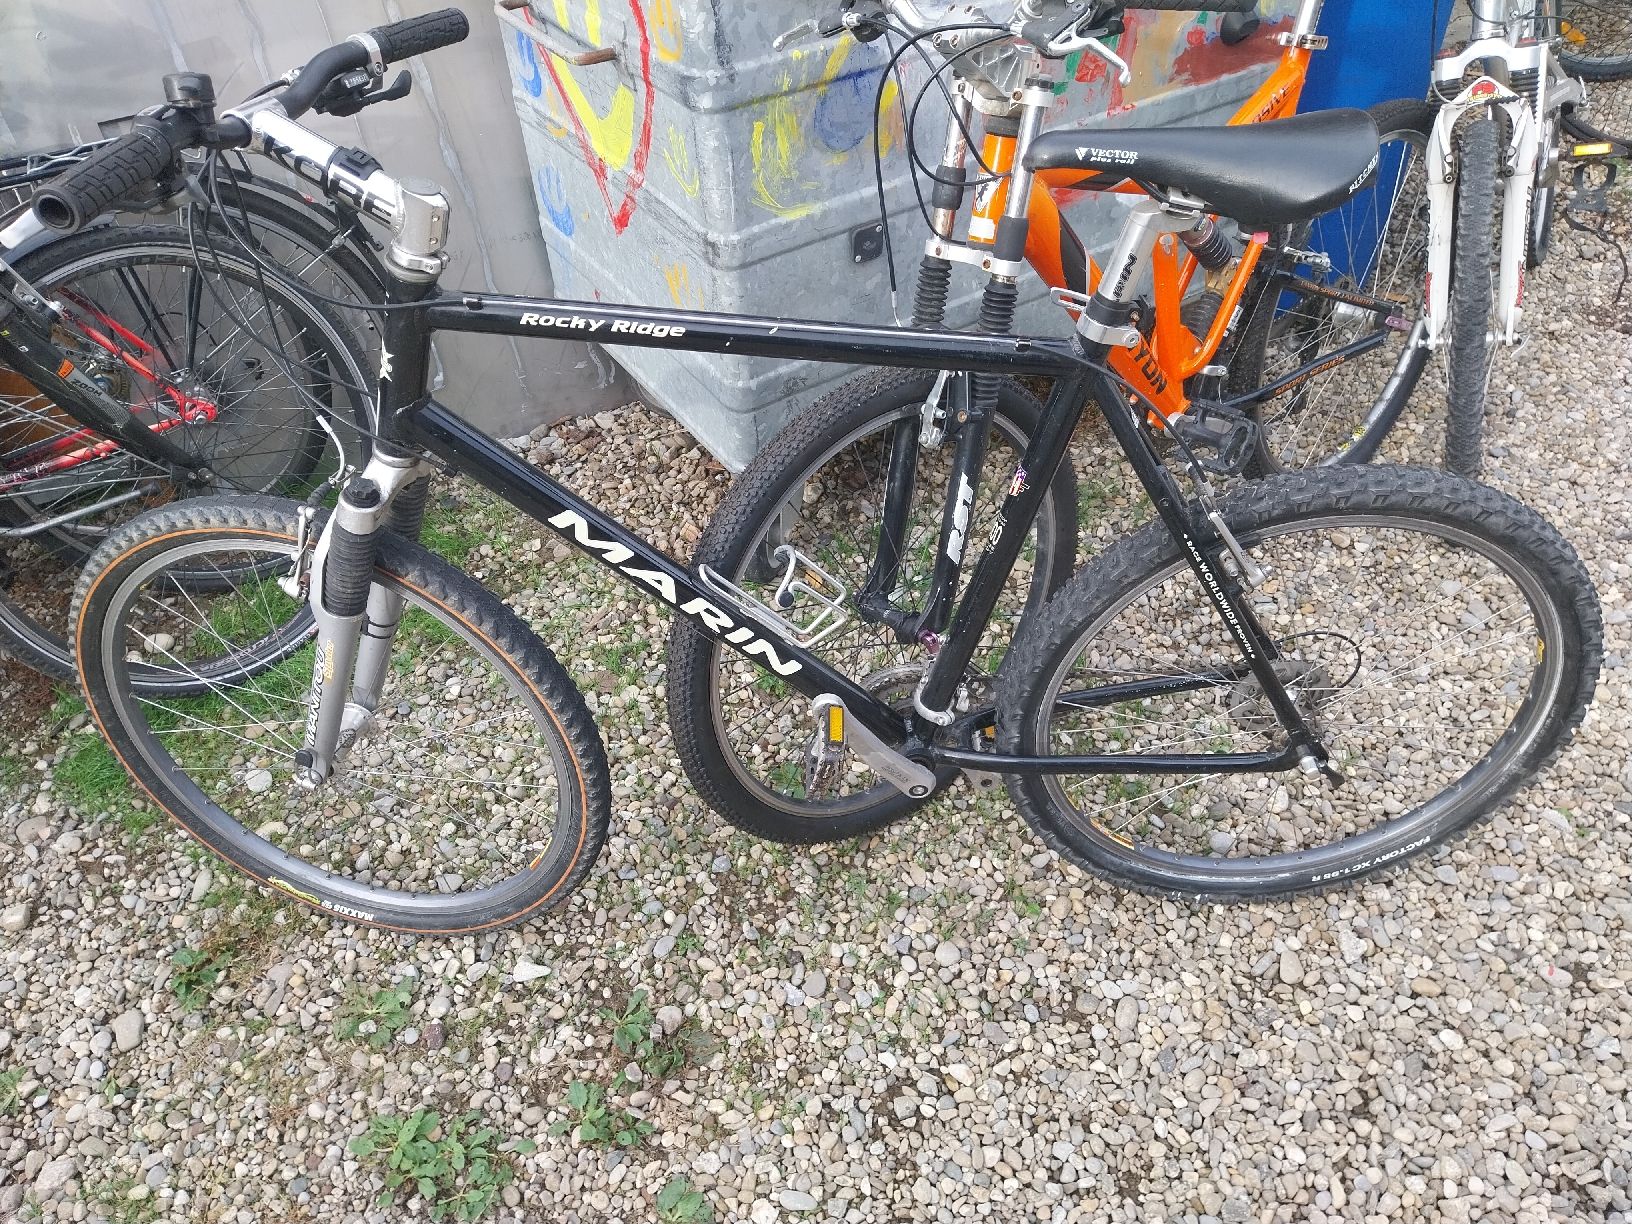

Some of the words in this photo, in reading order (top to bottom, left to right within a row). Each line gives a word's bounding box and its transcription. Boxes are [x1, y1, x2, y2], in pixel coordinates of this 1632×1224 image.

[263, 134, 397, 226] KORE
[1090, 147, 1139, 160] VECTOR
[519, 312, 606, 332] Rocky
[610, 319, 687, 338] Ridge
[69, 378, 103, 397] ZOOM
[946, 471, 974, 566] RST
[547, 509, 803, 677] MARIN
[1186, 540, 1202, 563] RACE
[1199, 562, 1239, 625] WORLDWIDE
[1234, 623, 1254, 653] PROVEN
[304, 645, 326, 748] MANITOU
[1373, 836, 1431, 865] FACTORY
[333, 903, 375, 921] MAXXIS
